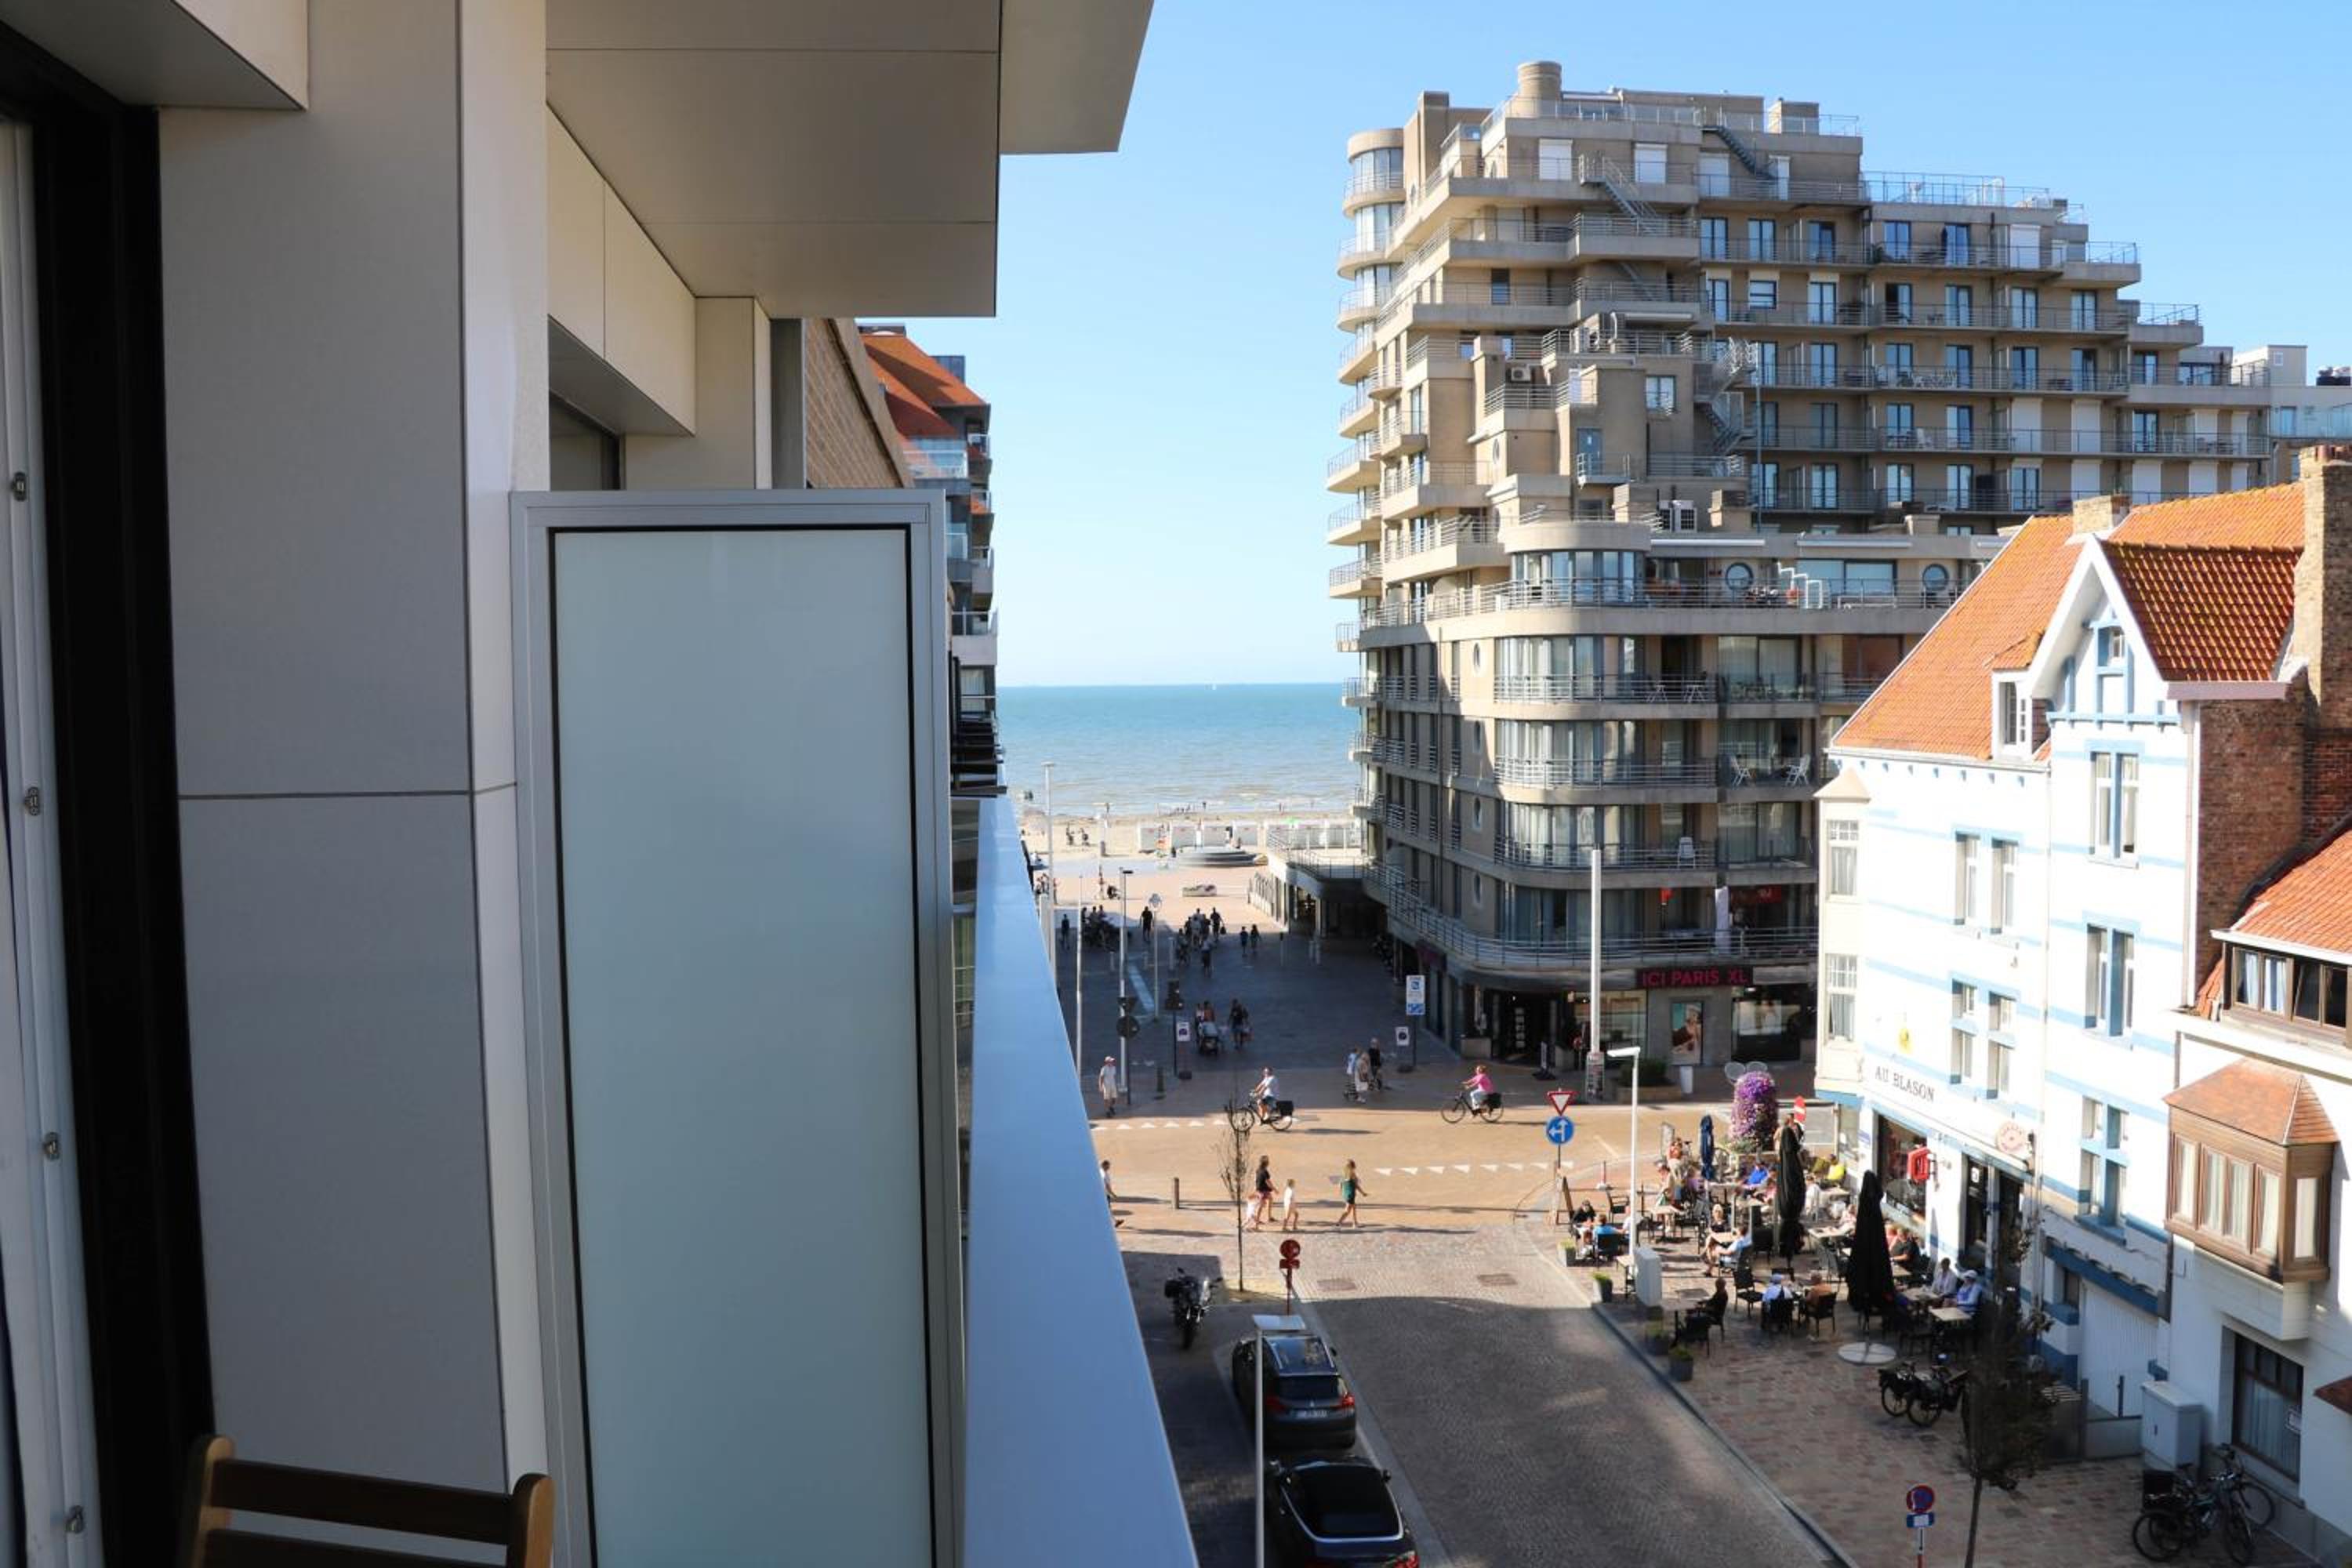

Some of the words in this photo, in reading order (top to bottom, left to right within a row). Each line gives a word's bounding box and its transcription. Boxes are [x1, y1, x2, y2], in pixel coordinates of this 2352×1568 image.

[1642, 971, 1666, 987] ICI
[1671, 968, 1719, 985] PARIS
[1730, 968, 1748, 983] XL
[1875, 1066, 1889, 1082] AU
[1893, 1073, 1935, 1102] BLASON
